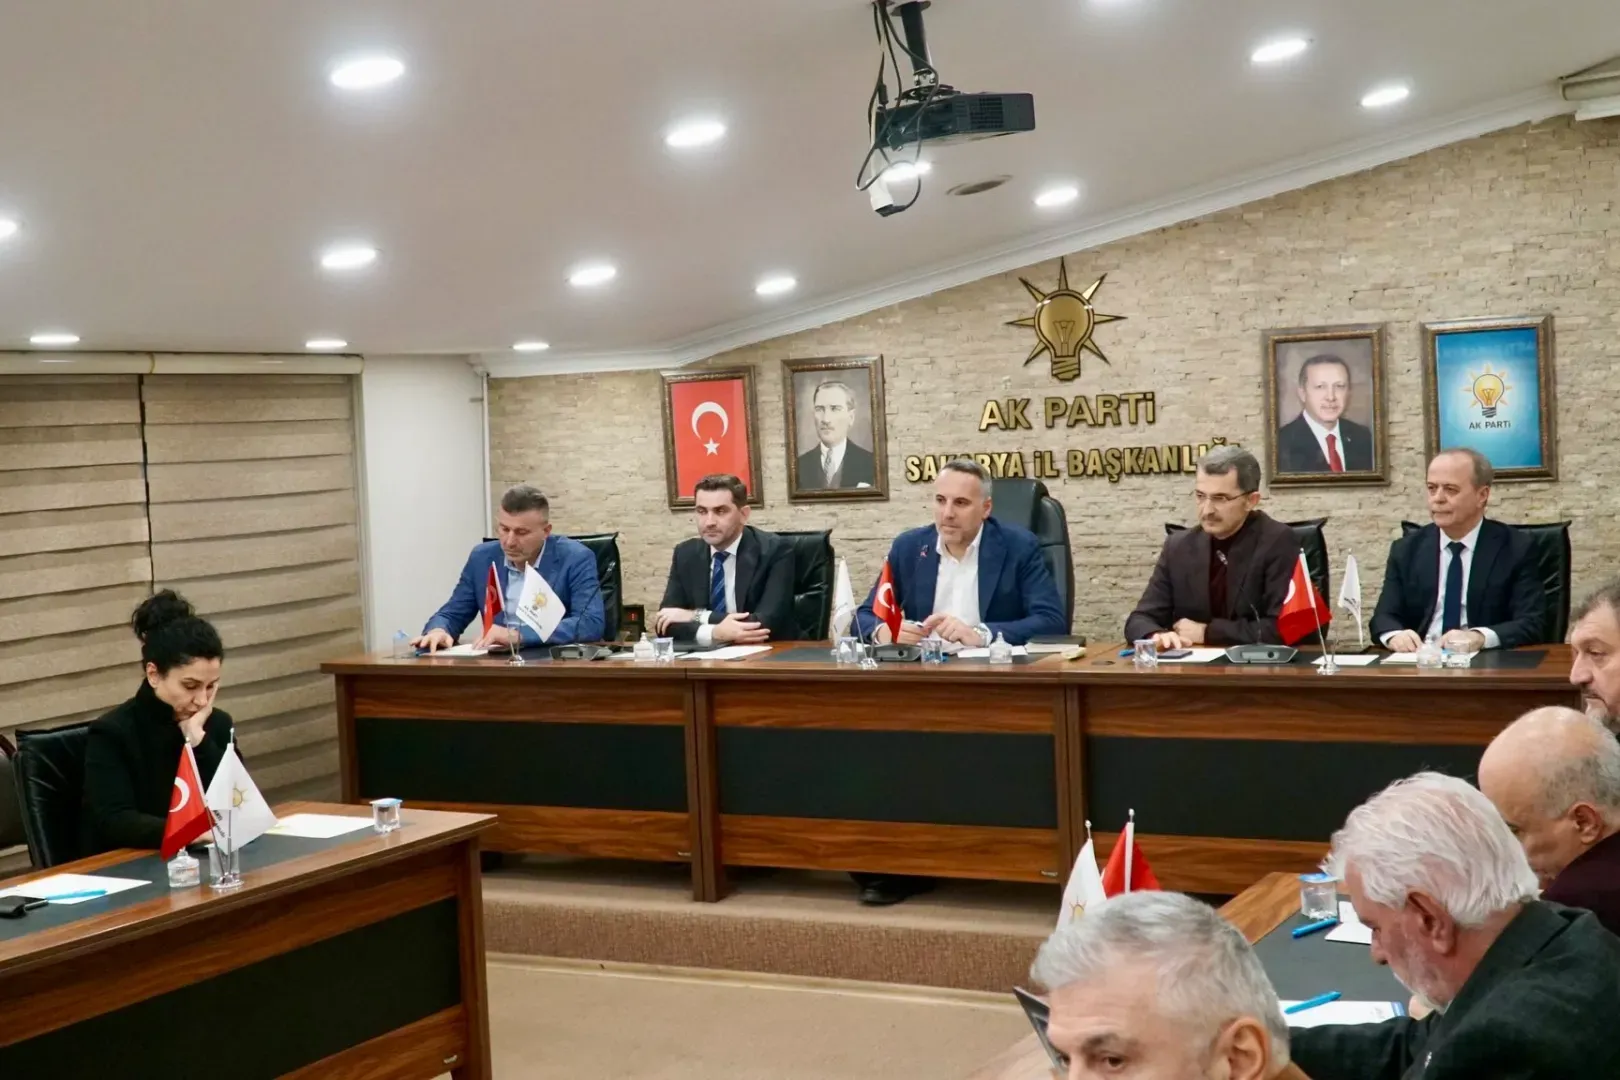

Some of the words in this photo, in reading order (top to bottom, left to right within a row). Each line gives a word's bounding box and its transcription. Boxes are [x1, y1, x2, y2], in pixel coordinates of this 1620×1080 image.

[979, 400, 1032, 432] AK
[1469, 421, 1482, 430] AK
[905, 452, 1026, 483] SARYA
